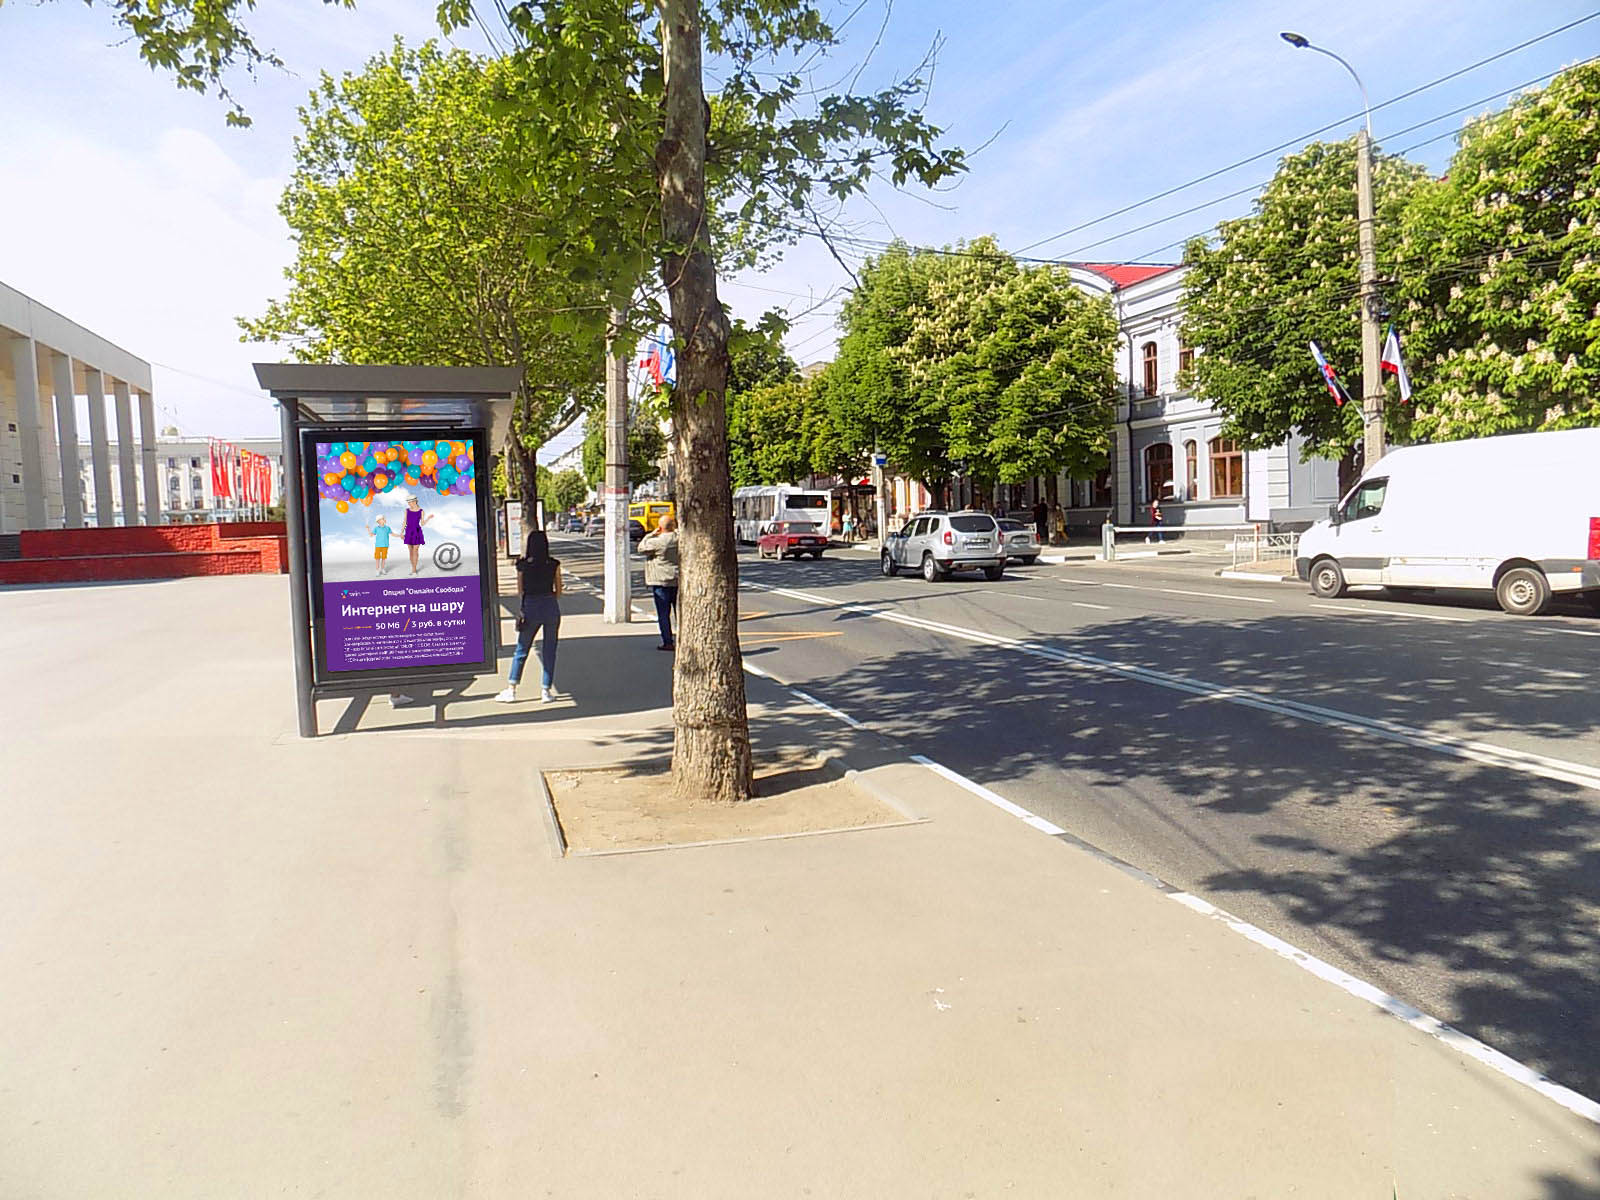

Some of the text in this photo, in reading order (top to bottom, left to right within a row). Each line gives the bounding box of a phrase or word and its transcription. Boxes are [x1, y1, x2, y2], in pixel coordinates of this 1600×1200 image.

[382, 589, 405, 597] Опция
[341, 601, 465, 618] Интернет на шару
[375, 622, 386, 630] 50
[387, 621, 400, 629] Мб
[411, 620, 417, 628] 3
[418, 620, 435, 629] руб.
[443, 619, 466, 628] сутки
